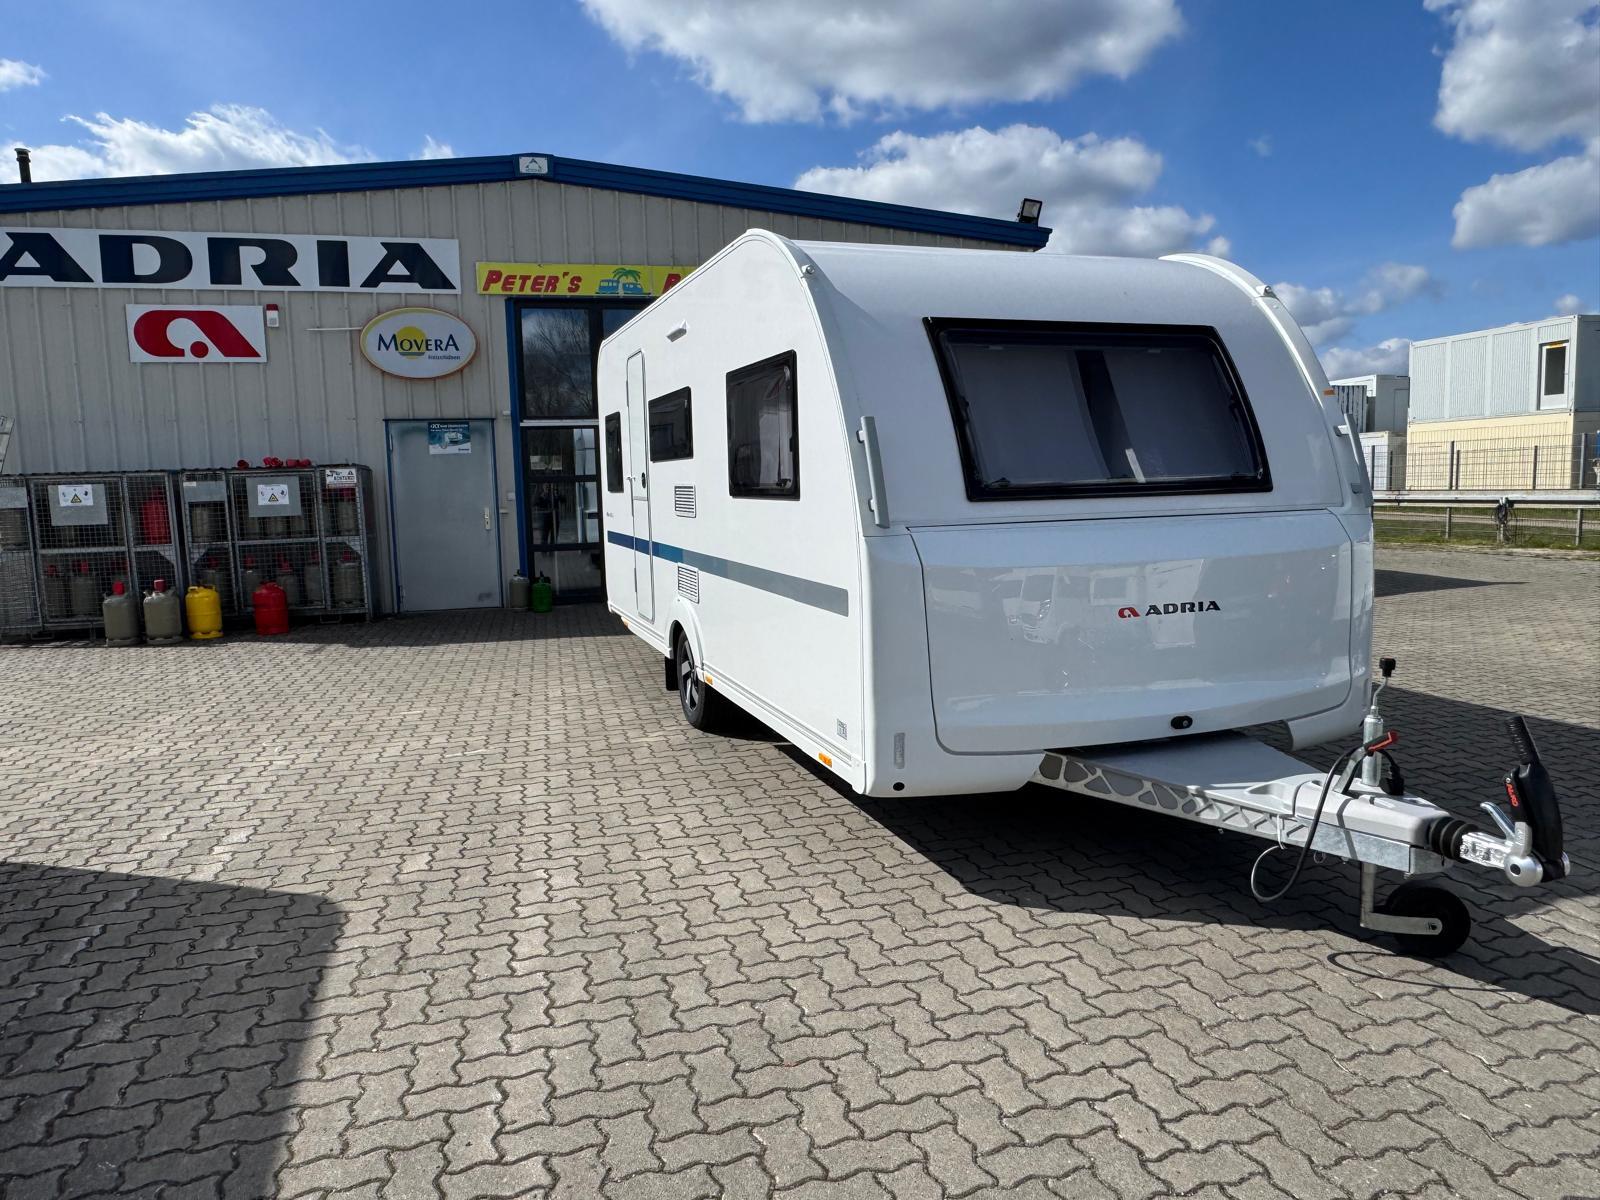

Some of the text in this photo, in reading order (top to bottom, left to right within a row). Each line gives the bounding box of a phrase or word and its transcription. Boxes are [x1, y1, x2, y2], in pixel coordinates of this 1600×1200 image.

[0, 232, 457, 289] ADRIA
[482, 270, 583, 293] PETER'S
[1145, 600, 1221, 617] ADRIA
